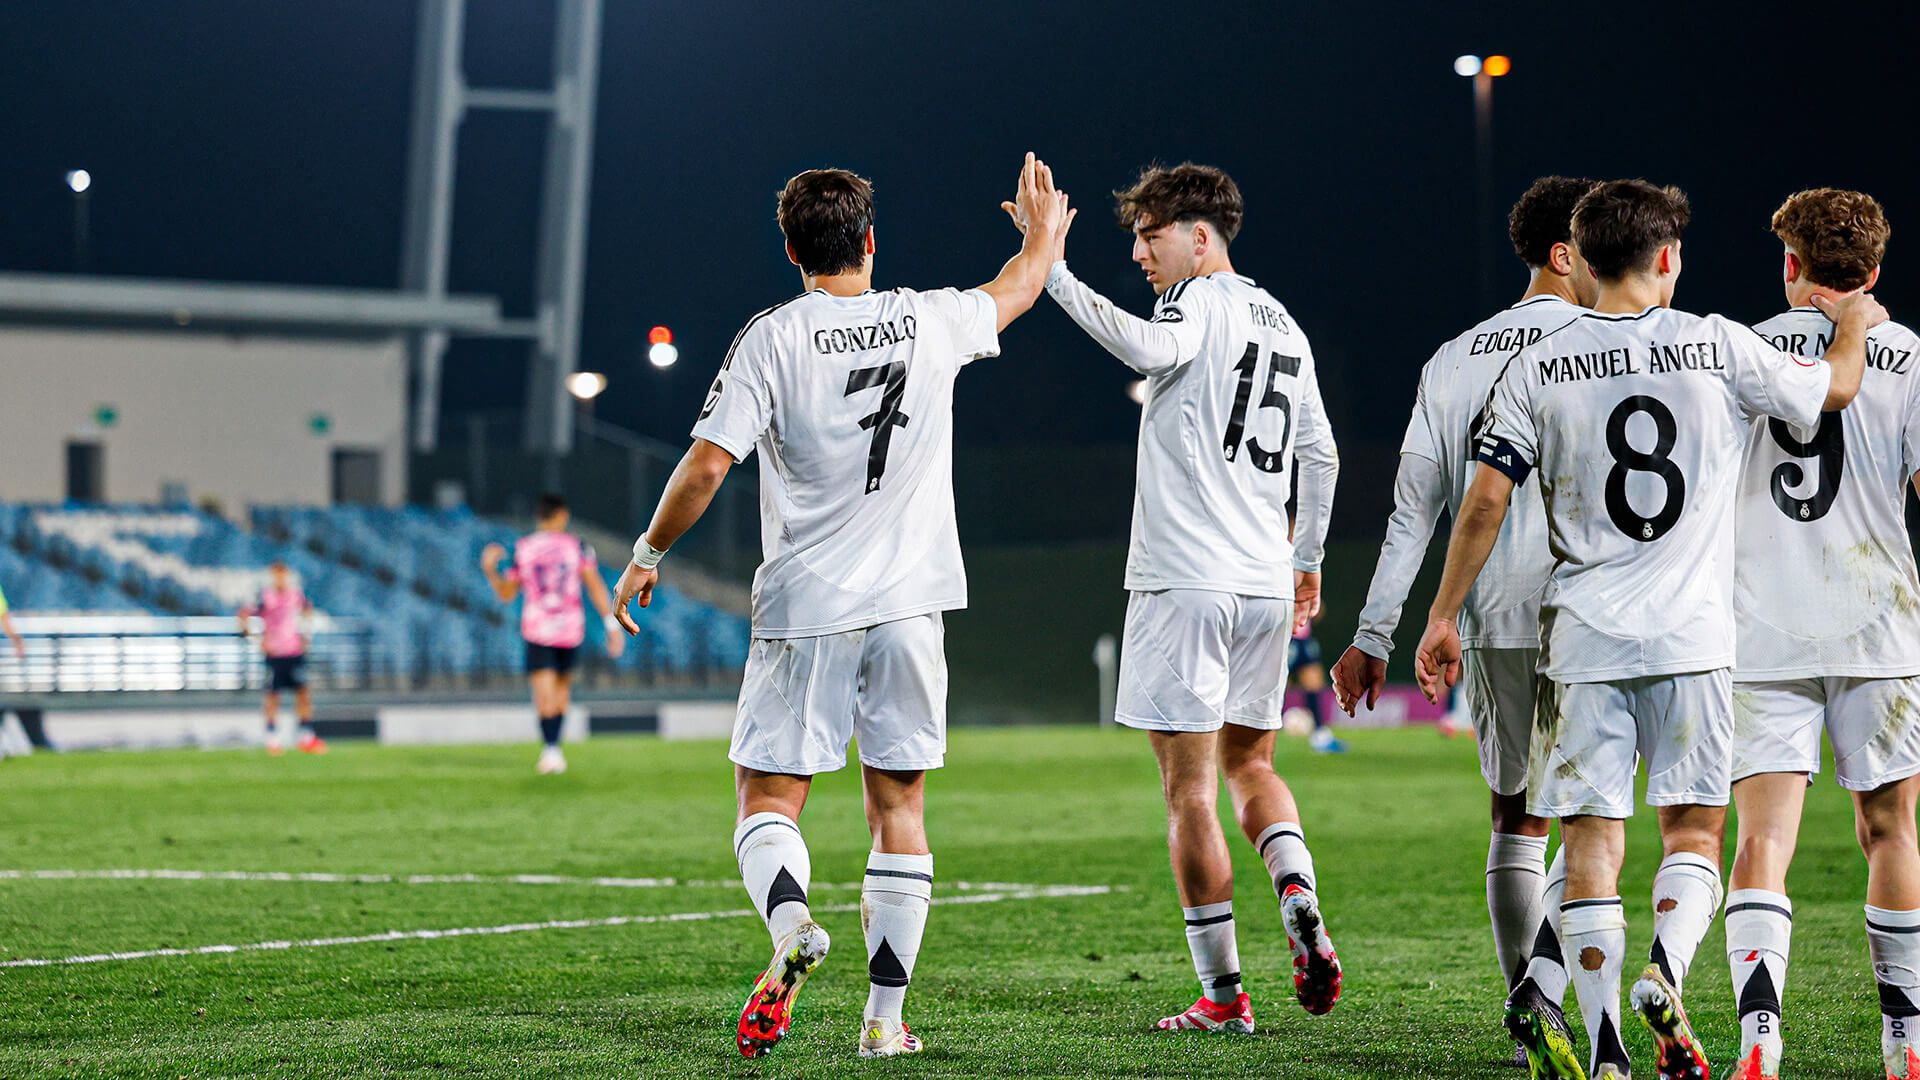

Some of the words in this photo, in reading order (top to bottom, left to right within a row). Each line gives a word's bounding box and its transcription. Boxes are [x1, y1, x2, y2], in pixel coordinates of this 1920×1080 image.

[814, 315, 916, 354] GONZALO
[1248, 302, 1289, 335] RIBES
[1538, 347, 1641, 386] MANUEL
[1649, 341, 1724, 374] ÁNGEL
[844, 360, 910, 495] 7
[1223, 340, 1301, 474] 15
[1605, 394, 1685, 543] 8
[1768, 410, 1845, 523] 9
